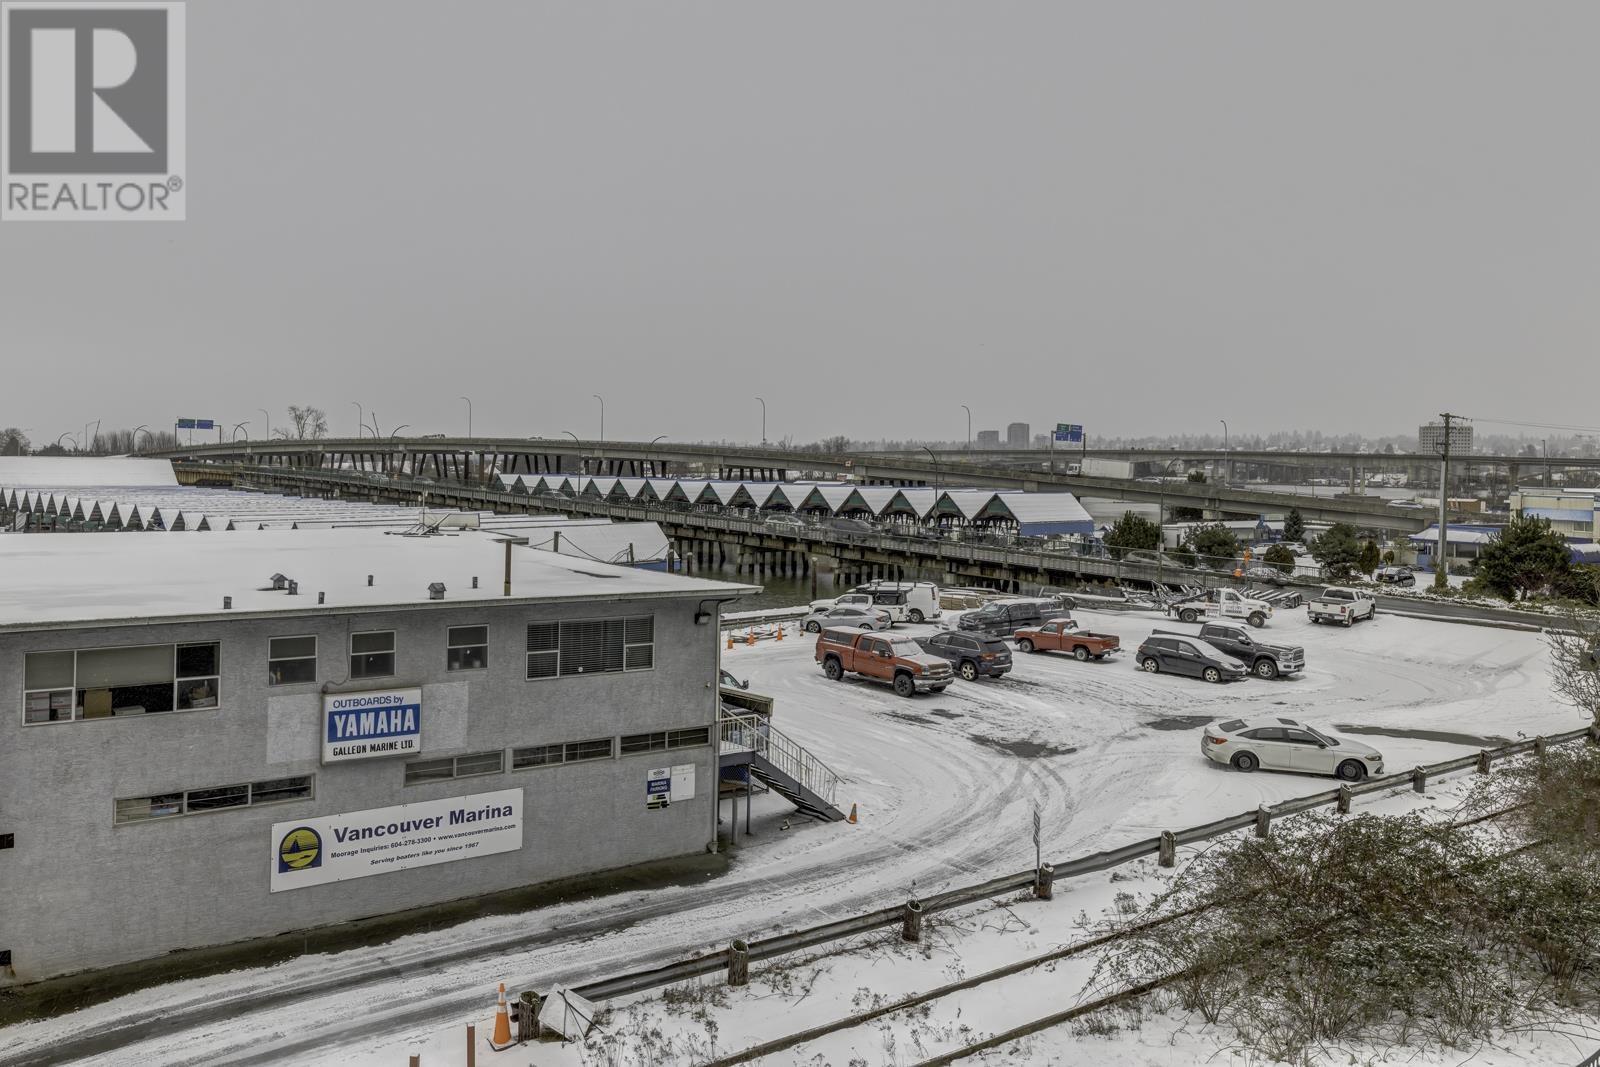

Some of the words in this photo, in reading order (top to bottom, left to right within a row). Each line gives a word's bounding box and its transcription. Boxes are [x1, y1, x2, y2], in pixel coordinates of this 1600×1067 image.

[333, 696, 392, 709] OUTBOARDS
[393, 695, 404, 705] by
[334, 709, 415, 738] YAMAHA
[333, 745, 367, 757] GALLEON
[369, 741, 398, 753] MARINE
[401, 740, 415, 749] LTD.
[333, 814, 443, 844] Vancouver
[449, 804, 513, 826] Marina
[330, 849, 359, 859] Moorage
[360, 844, 390, 854] Inquiries:
[390, 836, 432, 849] 604-278-3300
[438, 824, 516, 841] www.vancouvermarina.com
[370, 857, 395, 866] Serving
[396, 852, 420, 861] boaters
[434, 848, 445, 856] you
[446, 845, 463, 853] since
